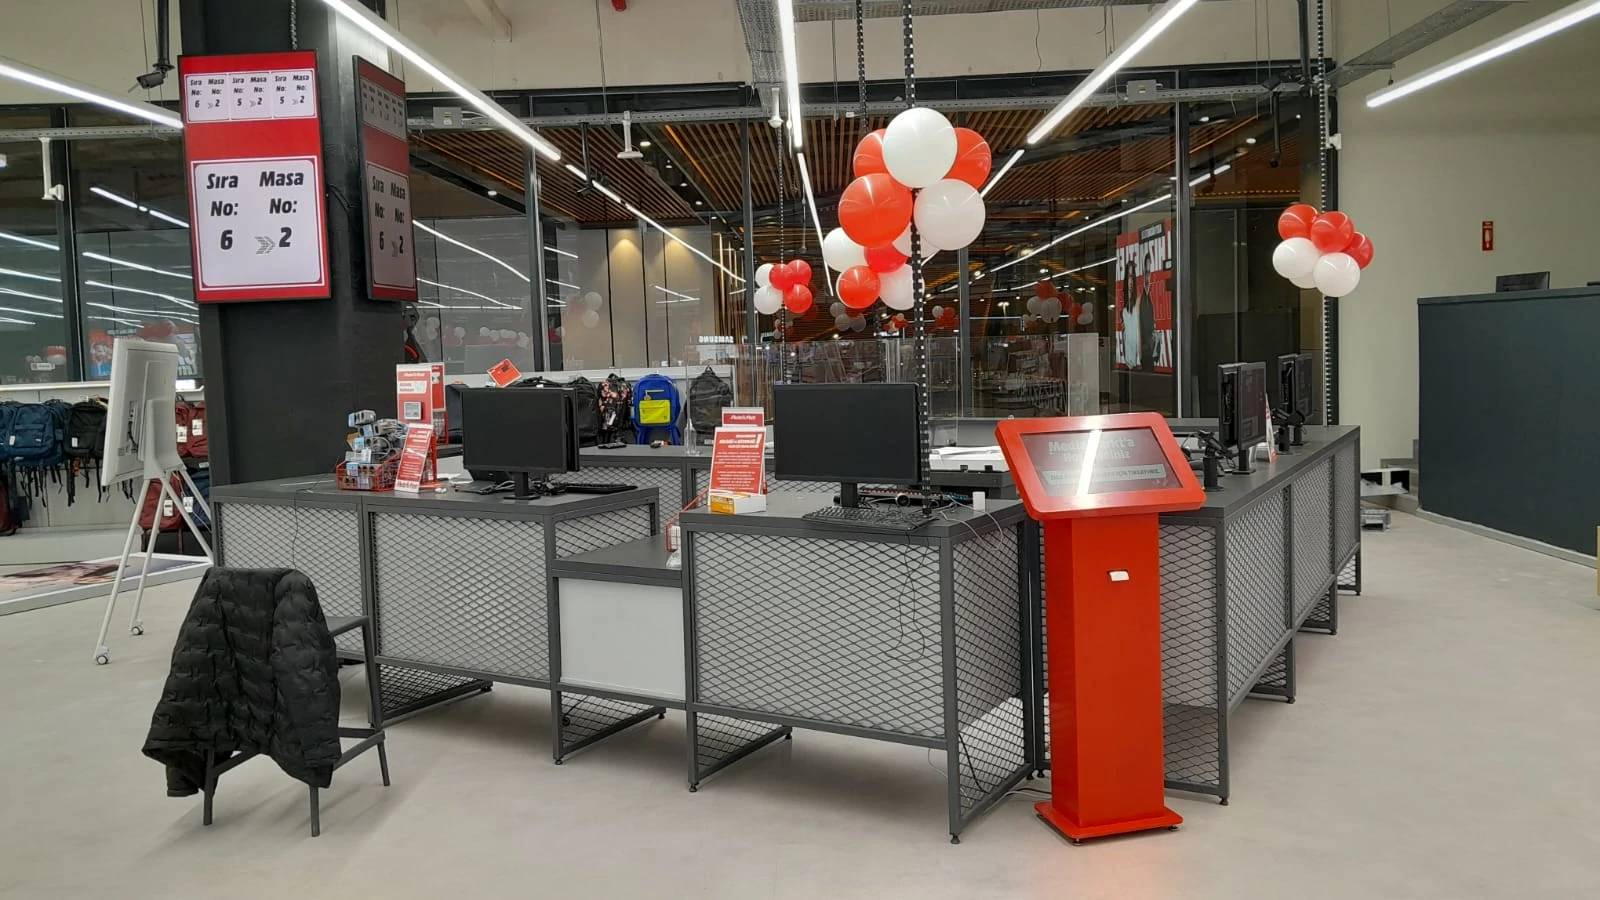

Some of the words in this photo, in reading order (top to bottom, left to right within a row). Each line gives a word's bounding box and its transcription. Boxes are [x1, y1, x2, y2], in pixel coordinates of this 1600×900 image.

[190, 79, 203, 87] Sıra
[194, 99, 200, 109] 6
[214, 99, 220, 108] 2
[237, 97, 242, 107] 5
[257, 97, 263, 106] 2
[279, 96, 285, 105] 5
[299, 95, 305, 104] 2
[207, 174, 238, 189] Sıra
[260, 171, 303, 186] Masa
[211, 201, 238, 216] No:
[270, 199, 297, 213] No:
[221, 230, 232, 250] 6
[279, 227, 292, 247] 2
[379, 231, 385, 251] 6
[399, 235, 404, 255] 2
